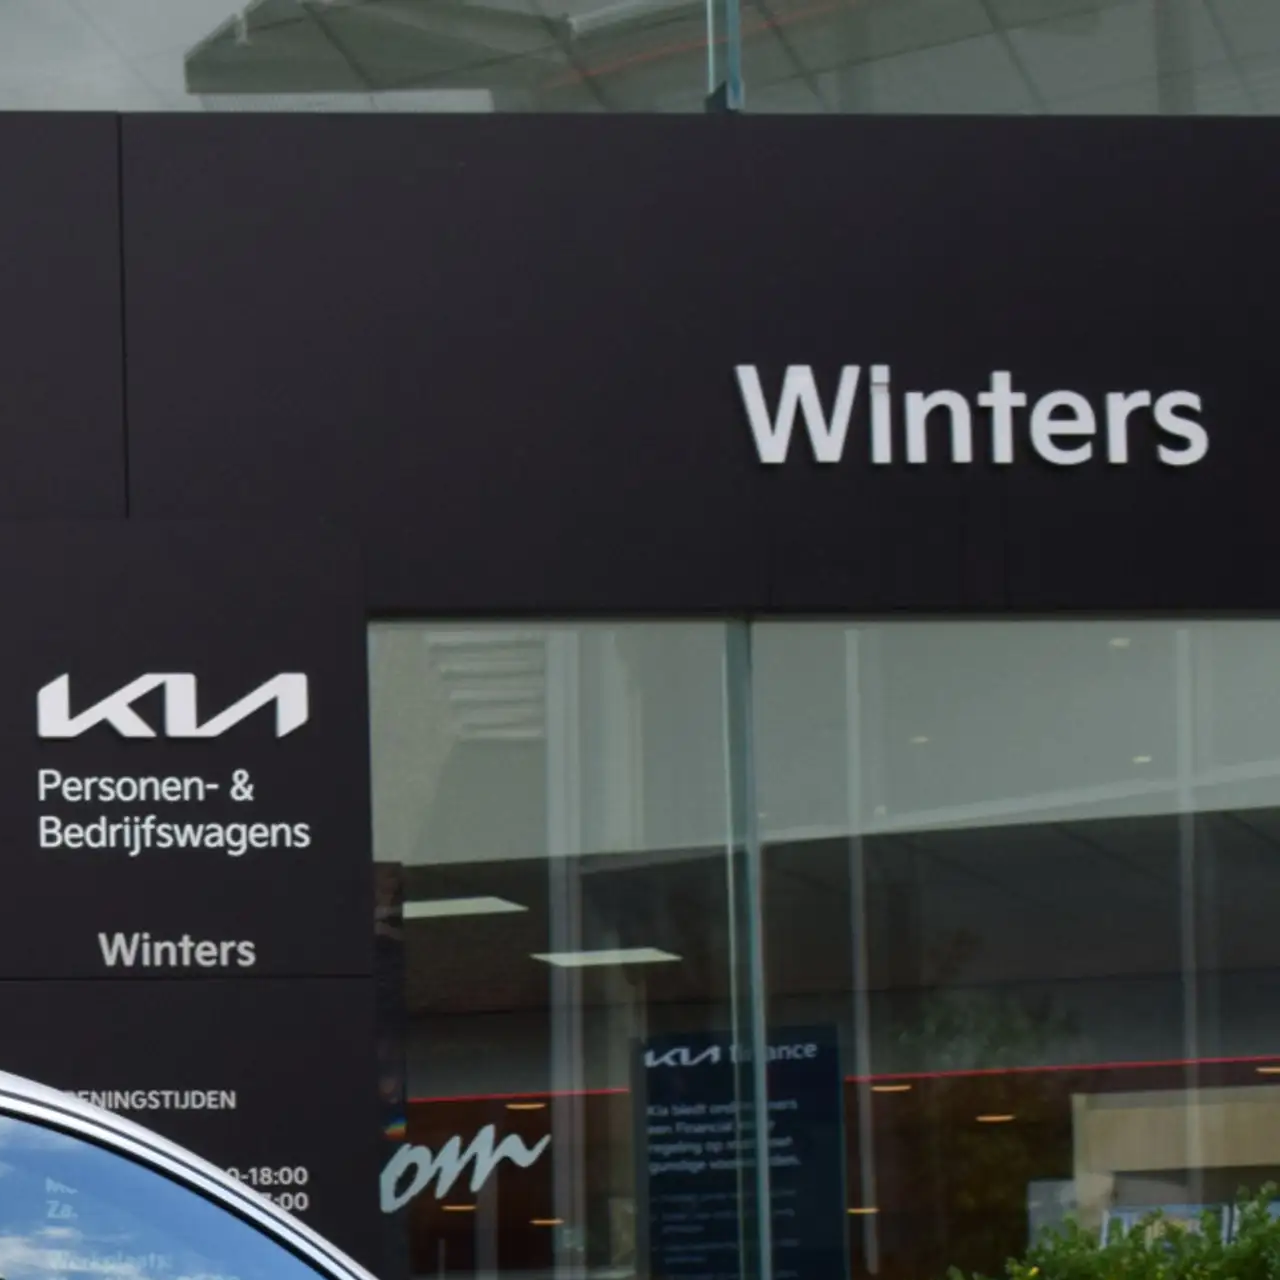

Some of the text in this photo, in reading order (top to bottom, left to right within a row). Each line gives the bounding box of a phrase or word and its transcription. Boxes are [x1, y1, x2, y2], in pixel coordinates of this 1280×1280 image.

[735, 363, 1210, 467] Winters
[36, 672, 309, 738] KIA
[38, 768, 255, 803] Personen- &
[38, 814, 312, 857] Bedrijfswagens
[97, 931, 257, 968] Winters
